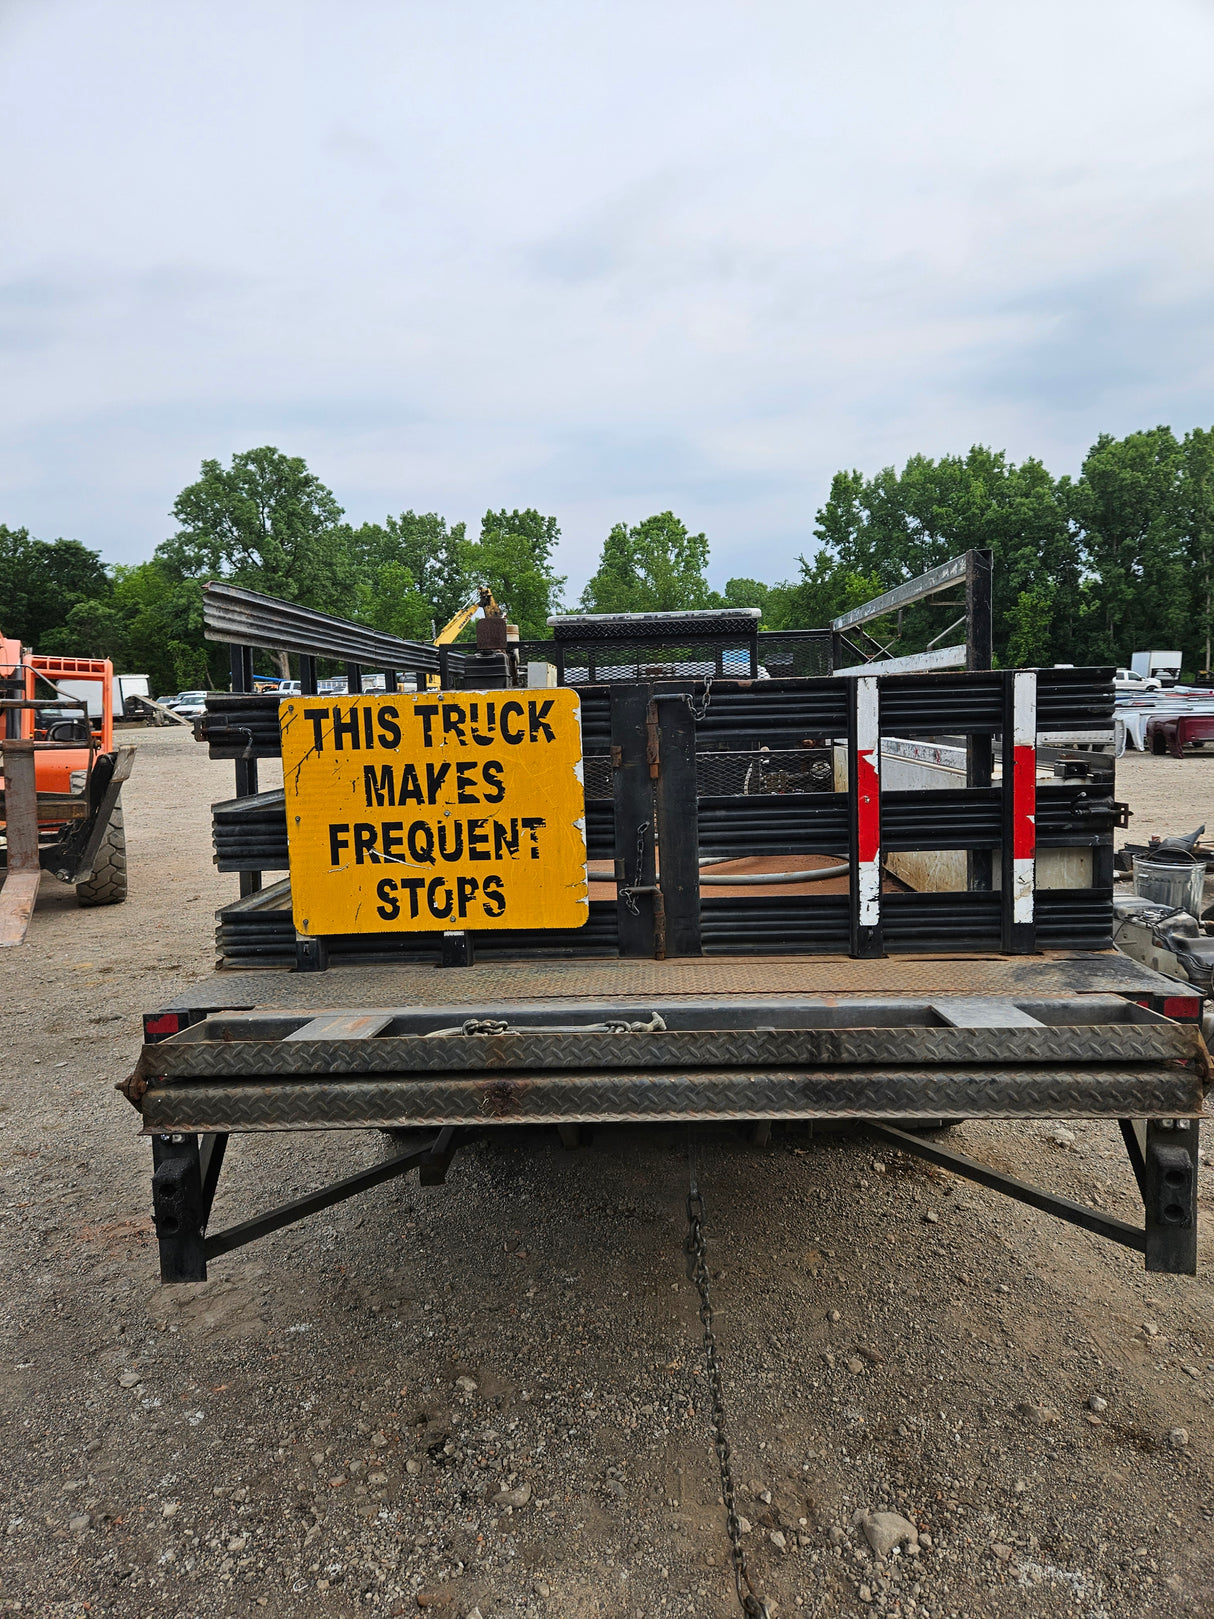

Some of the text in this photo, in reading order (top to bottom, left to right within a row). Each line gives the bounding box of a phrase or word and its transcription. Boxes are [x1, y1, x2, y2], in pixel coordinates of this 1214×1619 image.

[304, 700, 556, 751] THIS TRUCK
[363, 760, 506, 807] MAKES
[328, 817, 547, 866] FREQUENT
[376, 875, 506, 920] STOPS
